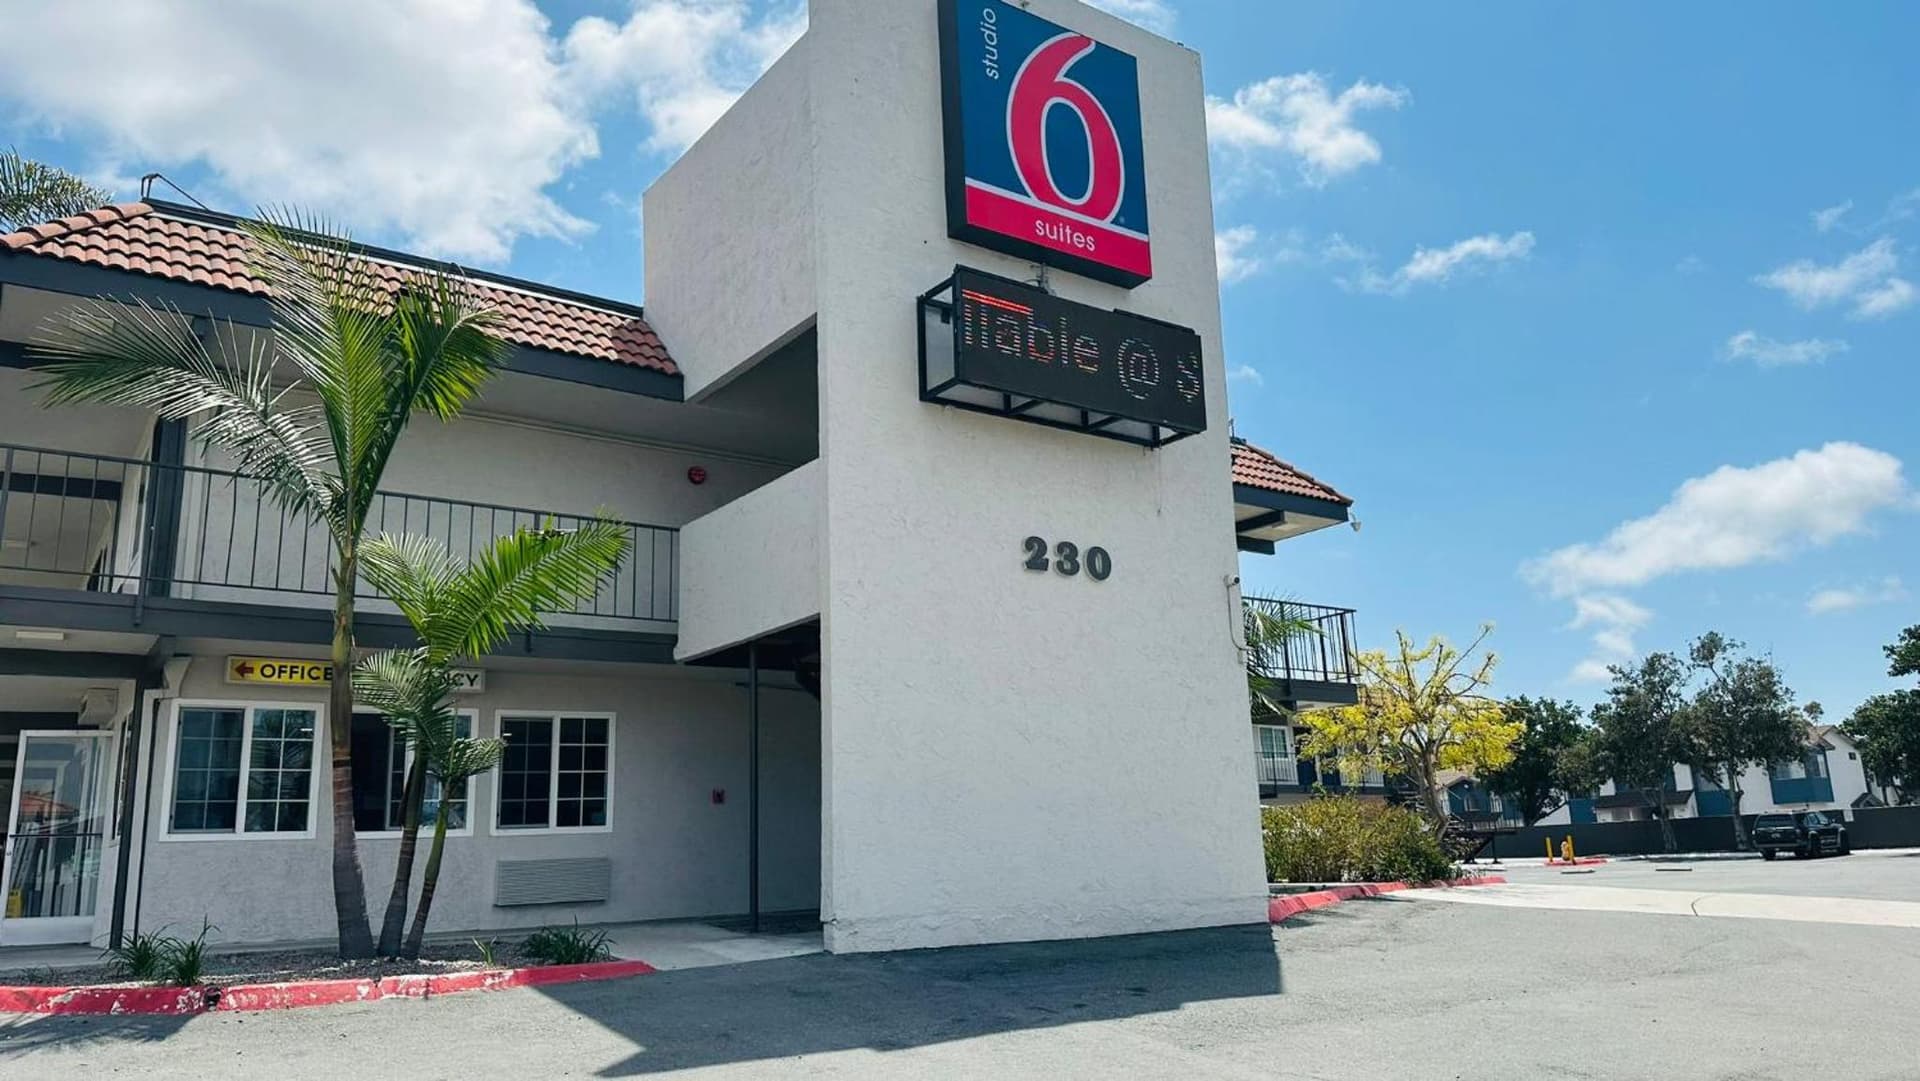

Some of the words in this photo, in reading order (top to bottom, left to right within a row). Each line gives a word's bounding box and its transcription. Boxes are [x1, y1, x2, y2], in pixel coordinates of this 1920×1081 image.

[980, 7, 999, 80] studio
[1006, 31, 1125, 224] 6
[1035, 219, 1096, 251] suites
[1118, 338, 1160, 400] @
[1024, 536, 1112, 581] 230
[260, 663, 334, 681] OFFICE
